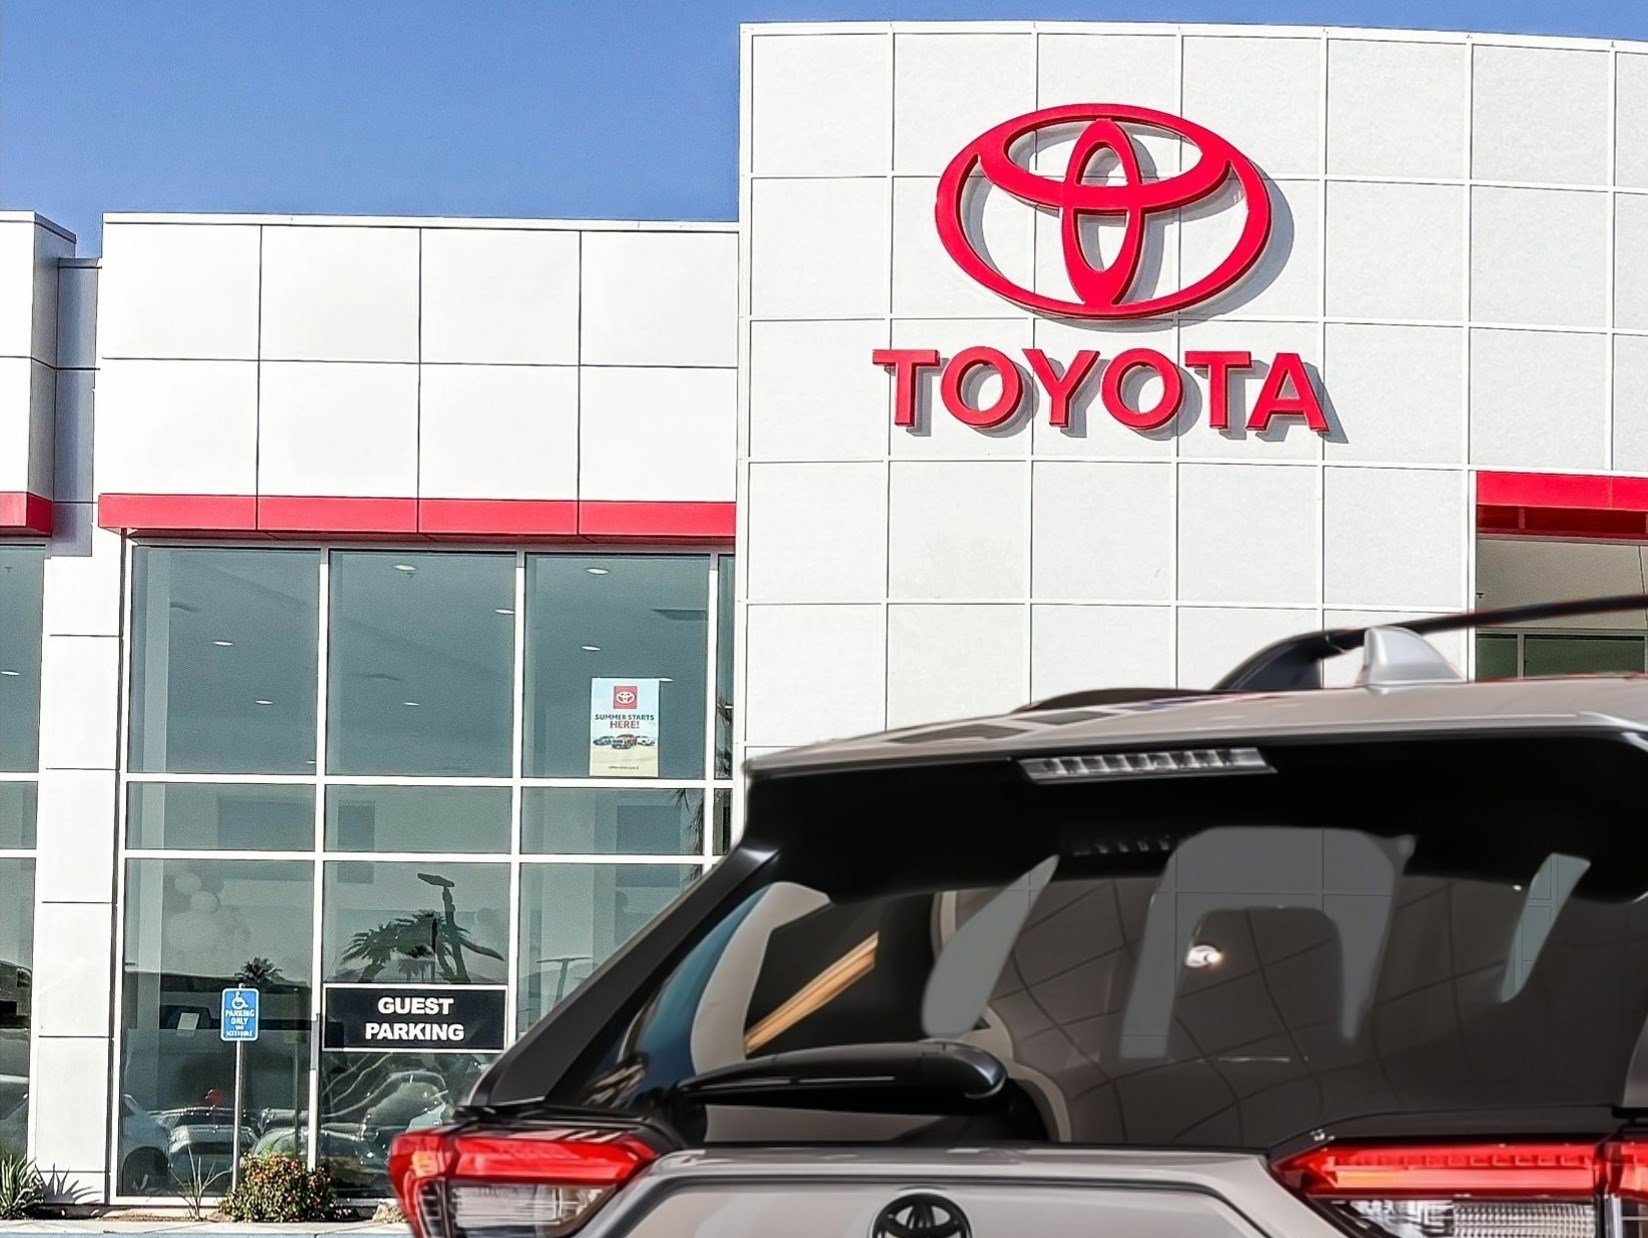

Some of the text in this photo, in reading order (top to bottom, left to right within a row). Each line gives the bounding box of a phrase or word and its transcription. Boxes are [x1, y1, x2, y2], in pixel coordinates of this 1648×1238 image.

[872, 346, 1330, 433] TOYOTA
[610, 720, 640, 729] HERE!
[377, 997, 454, 1015] GUEST
[365, 1022, 464, 1041] PARKING
